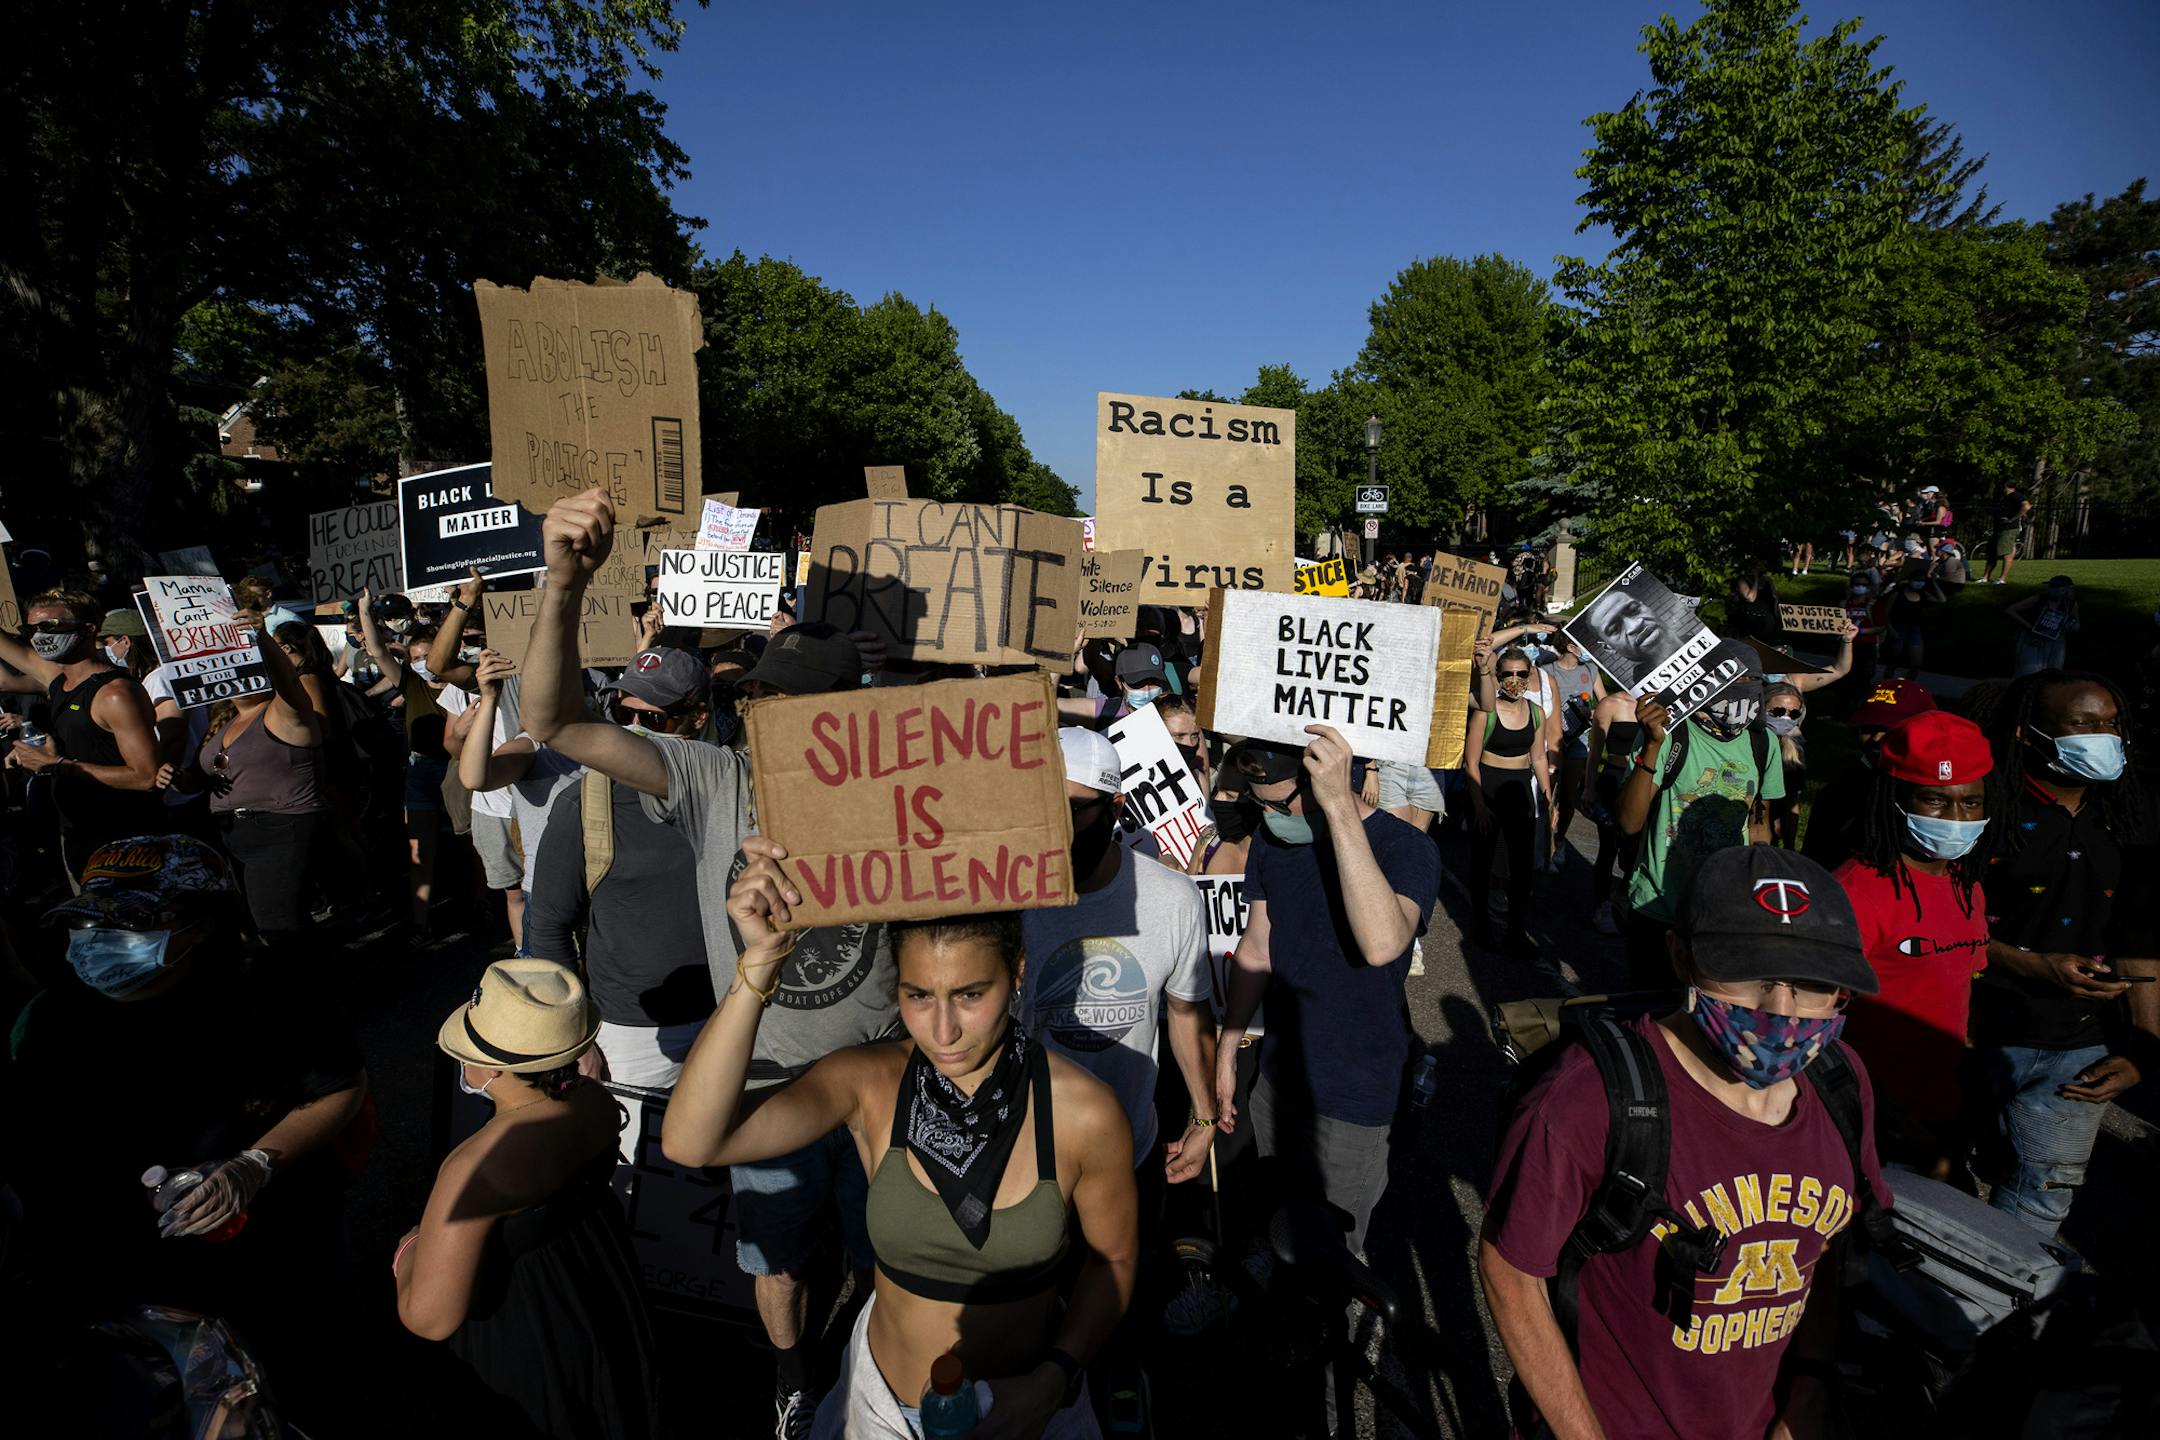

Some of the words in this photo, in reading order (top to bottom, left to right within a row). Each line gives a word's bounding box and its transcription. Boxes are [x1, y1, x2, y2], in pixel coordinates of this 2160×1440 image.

[508, 318, 667, 398] ABOLISH
[559, 392, 601, 425] THE
[1108, 400, 1281, 445] Racism
[526, 431, 628, 506] POLICE
[418, 484, 472, 510] BLACK
[1141, 472, 1193, 505] Is
[1226, 485, 1251, 509] a
[312, 512, 339, 547] HE
[344, 502, 398, 541] COULD
[446, 509, 514, 534] MATTER
[325, 532, 398, 563] FUCKING
[661, 552, 695, 576] NO
[701, 552, 781, 579] JUSTICE
[1431, 565, 1500, 597] DEMAND
[1456, 557, 1476, 574] WE
[1089, 579, 1133, 593] Silence
[174, 596, 205, 610] I
[174, 608, 213, 626] Can't
[488, 595, 536, 620] WE
[660, 592, 696, 617] NO
[706, 591, 772, 621] PEACE
[1781, 606, 1794, 616] NO
[1798, 606, 1842, 618] JUSTICE
[166, 623, 252, 655] BREATHE
[1278, 615, 1374, 651] BLACK
[1784, 618, 1798, 628] NO
[1802, 618, 1834, 631] PEACE
[174, 651, 254, 678] JUSTICE
[207, 670, 233, 683] FOR
[1276, 648, 1369, 686] LIVES
[1640, 635, 1712, 697] JUSTICE
[1676, 668, 1700, 691] FOR
[181, 675, 268, 705] FLOYD
[1666, 658, 1738, 725] FLOYD
[1274, 683, 1408, 732] MATTER
[804, 698, 1047, 786] SILENCE
[894, 785, 945, 849] IS
[796, 845, 1065, 909] VIOLENCE
[778, 993, 808, 1005] BOAT
[815, 987, 844, 1005] DOPE
[848, 968, 864, 988] 666
[1093, 1005, 1145, 1023] WOODS
[1628, 1106, 1657, 1117] CHROME
[1650, 1173, 1854, 1242] INNESO
